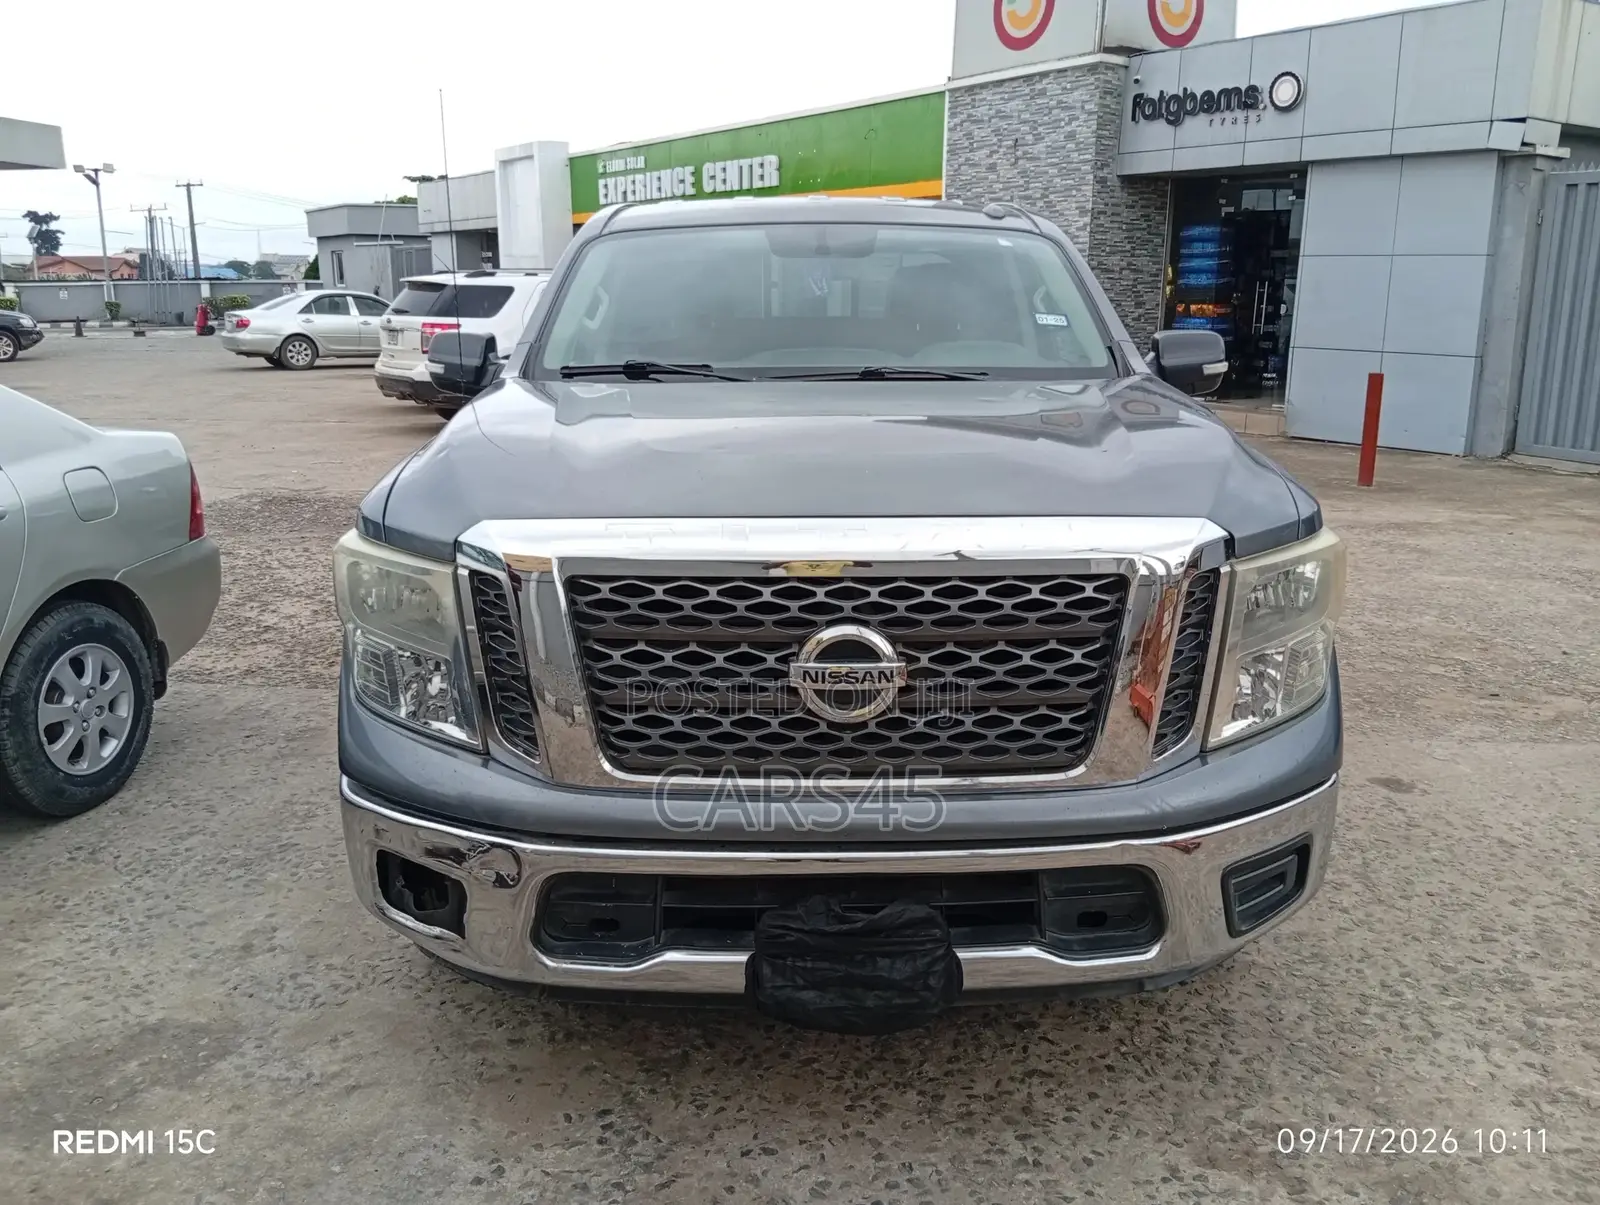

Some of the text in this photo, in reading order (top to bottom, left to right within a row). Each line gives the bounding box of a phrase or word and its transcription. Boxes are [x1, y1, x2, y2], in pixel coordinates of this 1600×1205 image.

[598, 166, 695, 205] EXPERIENCE
[702, 154, 780, 194] CENTER
[802, 668, 896, 685] NISSAN
